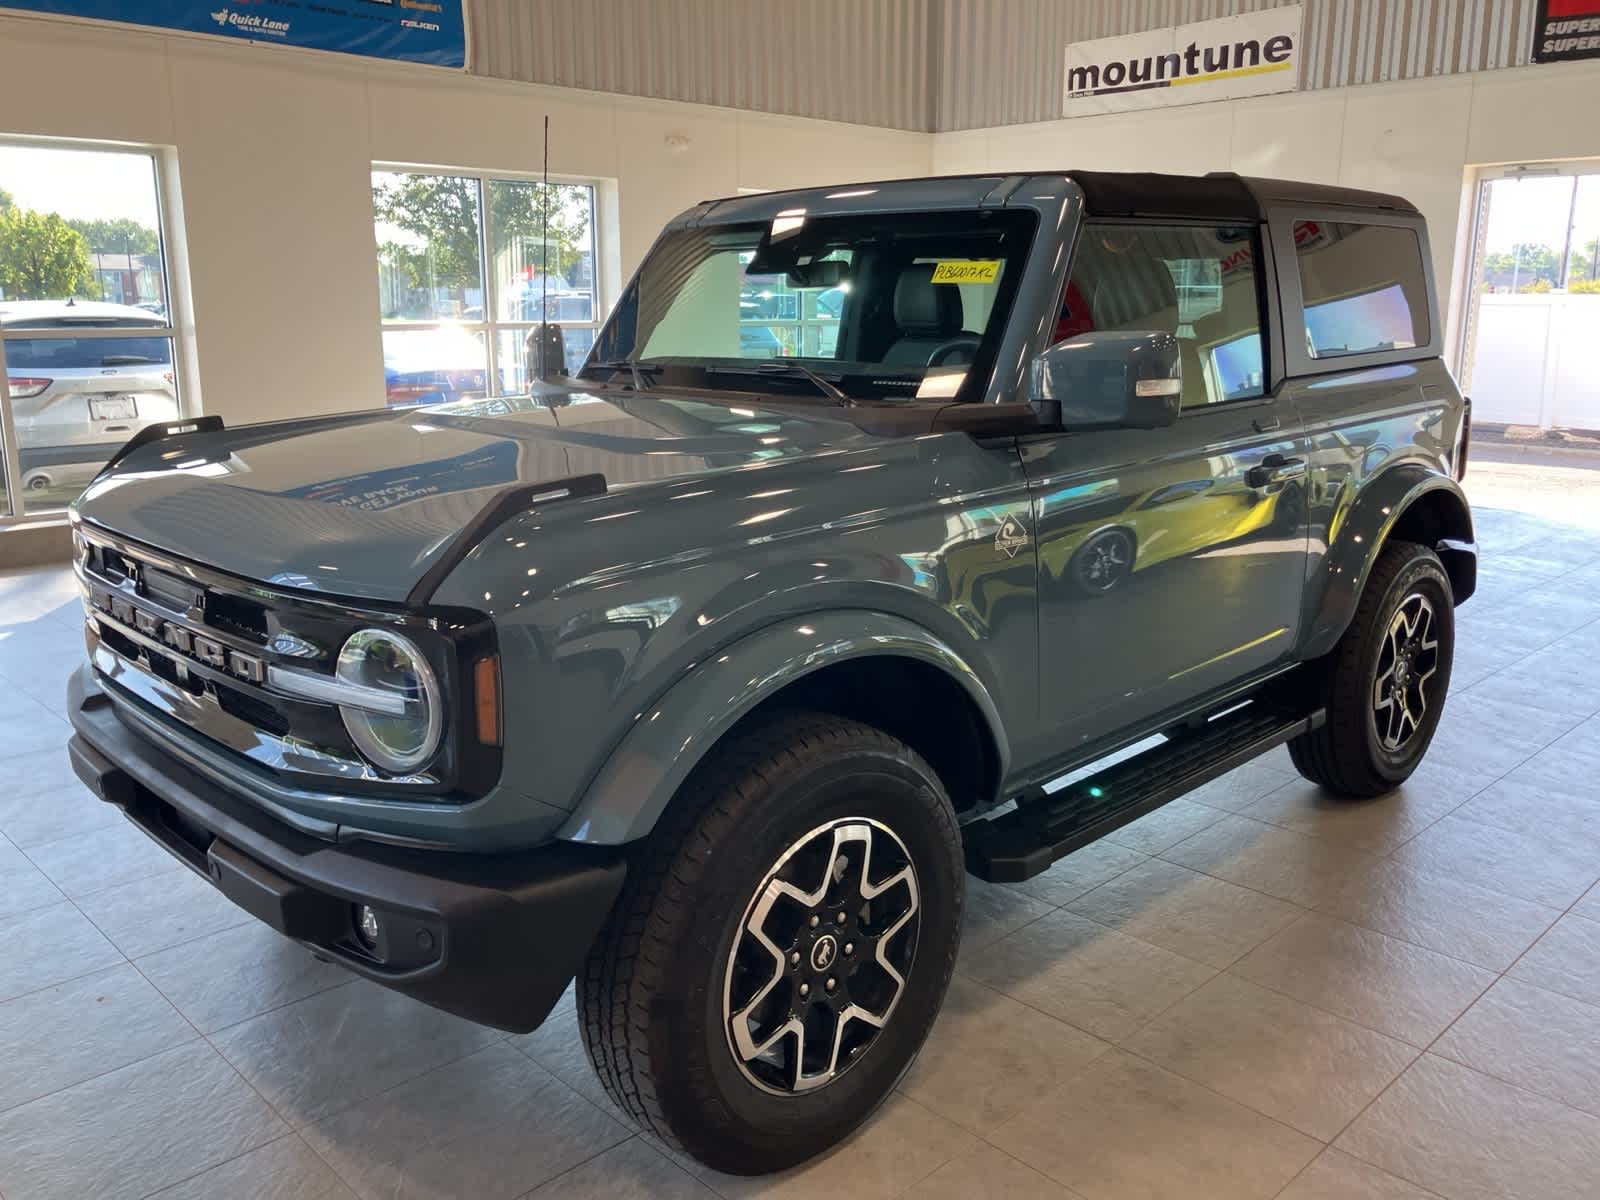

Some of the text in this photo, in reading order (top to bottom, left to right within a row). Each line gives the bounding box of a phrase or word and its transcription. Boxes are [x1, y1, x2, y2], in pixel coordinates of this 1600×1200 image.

[228, 12, 290, 31] Quick Lane
[1067, 33, 1294, 92] mountune
[89, 582, 264, 683] BRONCO
